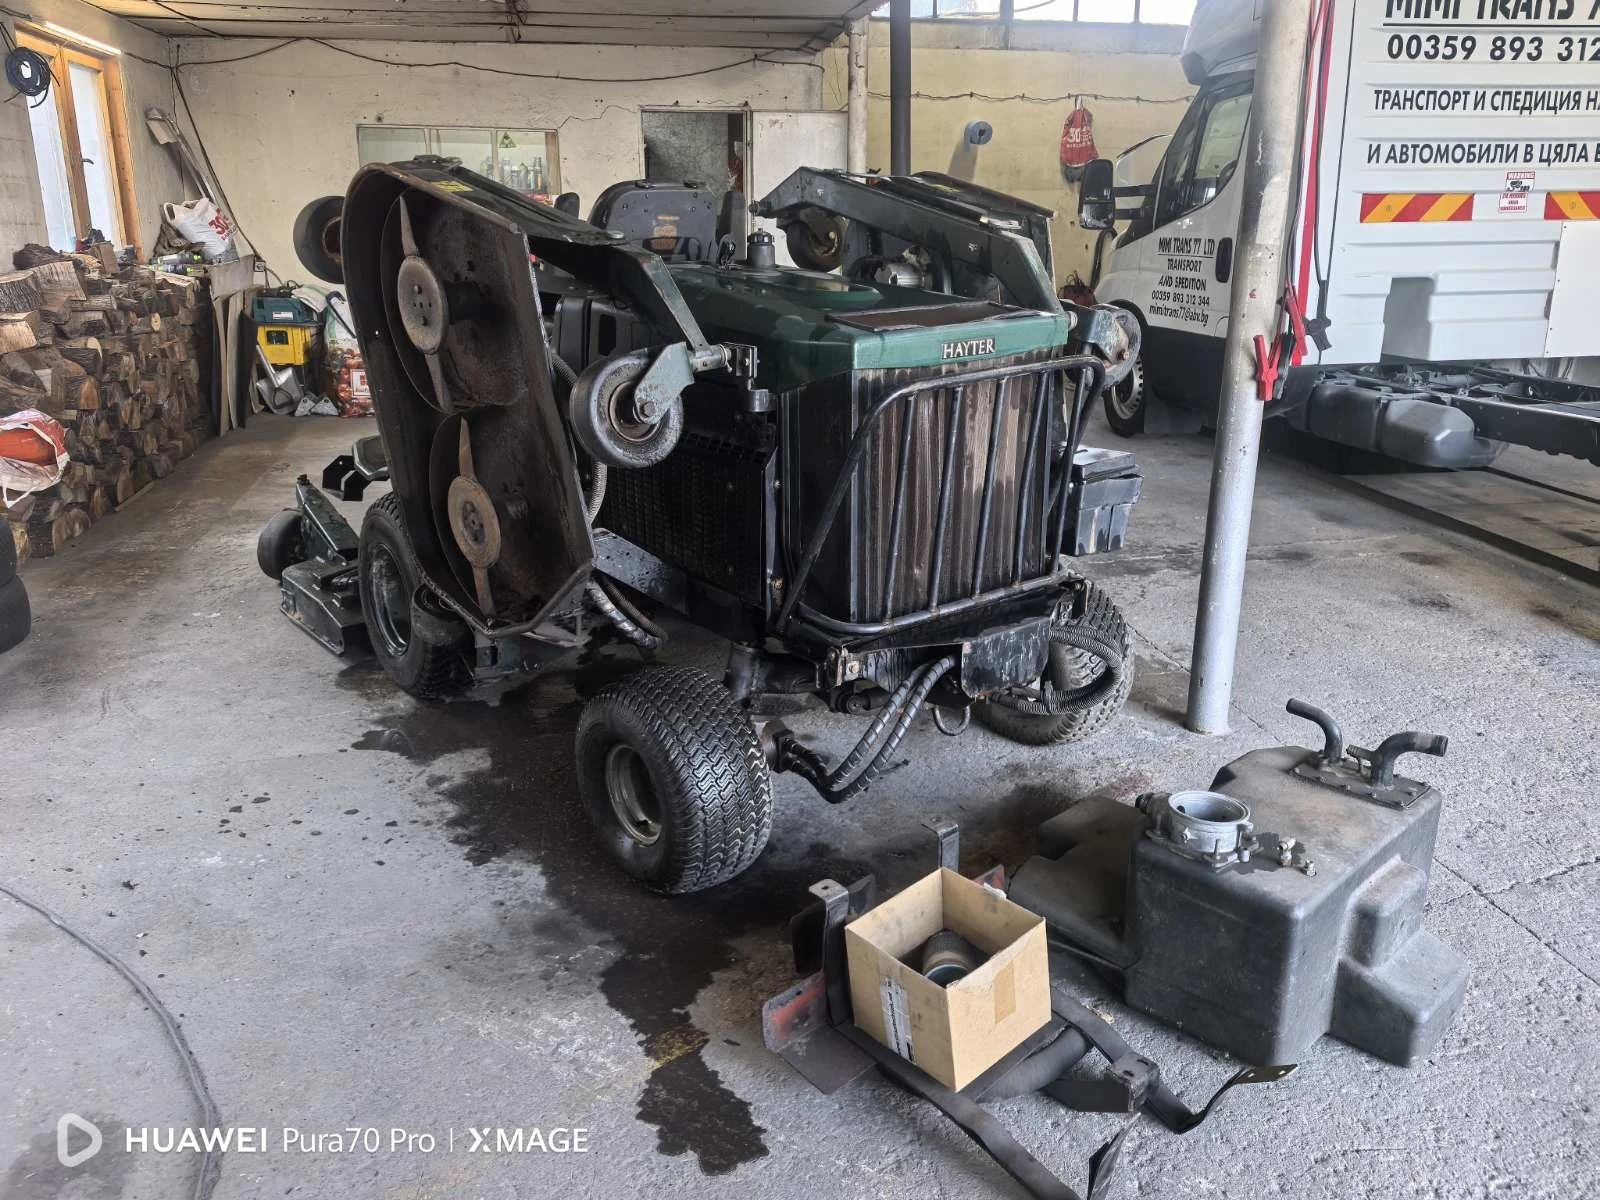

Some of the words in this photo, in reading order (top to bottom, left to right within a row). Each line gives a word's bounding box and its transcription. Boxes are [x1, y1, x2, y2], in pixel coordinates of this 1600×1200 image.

[1387, 34, 1477, 61] 00359
[1490, 36, 1544, 62] 893
[1374, 89, 1471, 111] ТРАНСПОРТ
[1473, 90, 1487, 111] И
[1490, 90, 1582, 115] СПЕДИЦИЯ
[1367, 143, 1381, 164] И
[1385, 143, 1519, 164] АВТОМОБИЛИ
[1523, 143, 1534, 163] В
[1539, 143, 1589, 167] ЦЯЛА
[1173, 237, 1192, 254] TRANS
[1193, 238, 1202, 255] 77
[1203, 238, 1216, 256] LTD
[1167, 258, 1202, 273] TRANSPORT
[1159, 275, 1173, 288] AND
[1174, 276, 1207, 291] SPEDITION
[1151, 290, 1171, 302] 00359
[1172, 292, 1184, 304] 893
[1186, 294, 1197, 305] 312
[1198, 295, 1210, 307] 344
[943, 338, 996, 359] HAYTER
